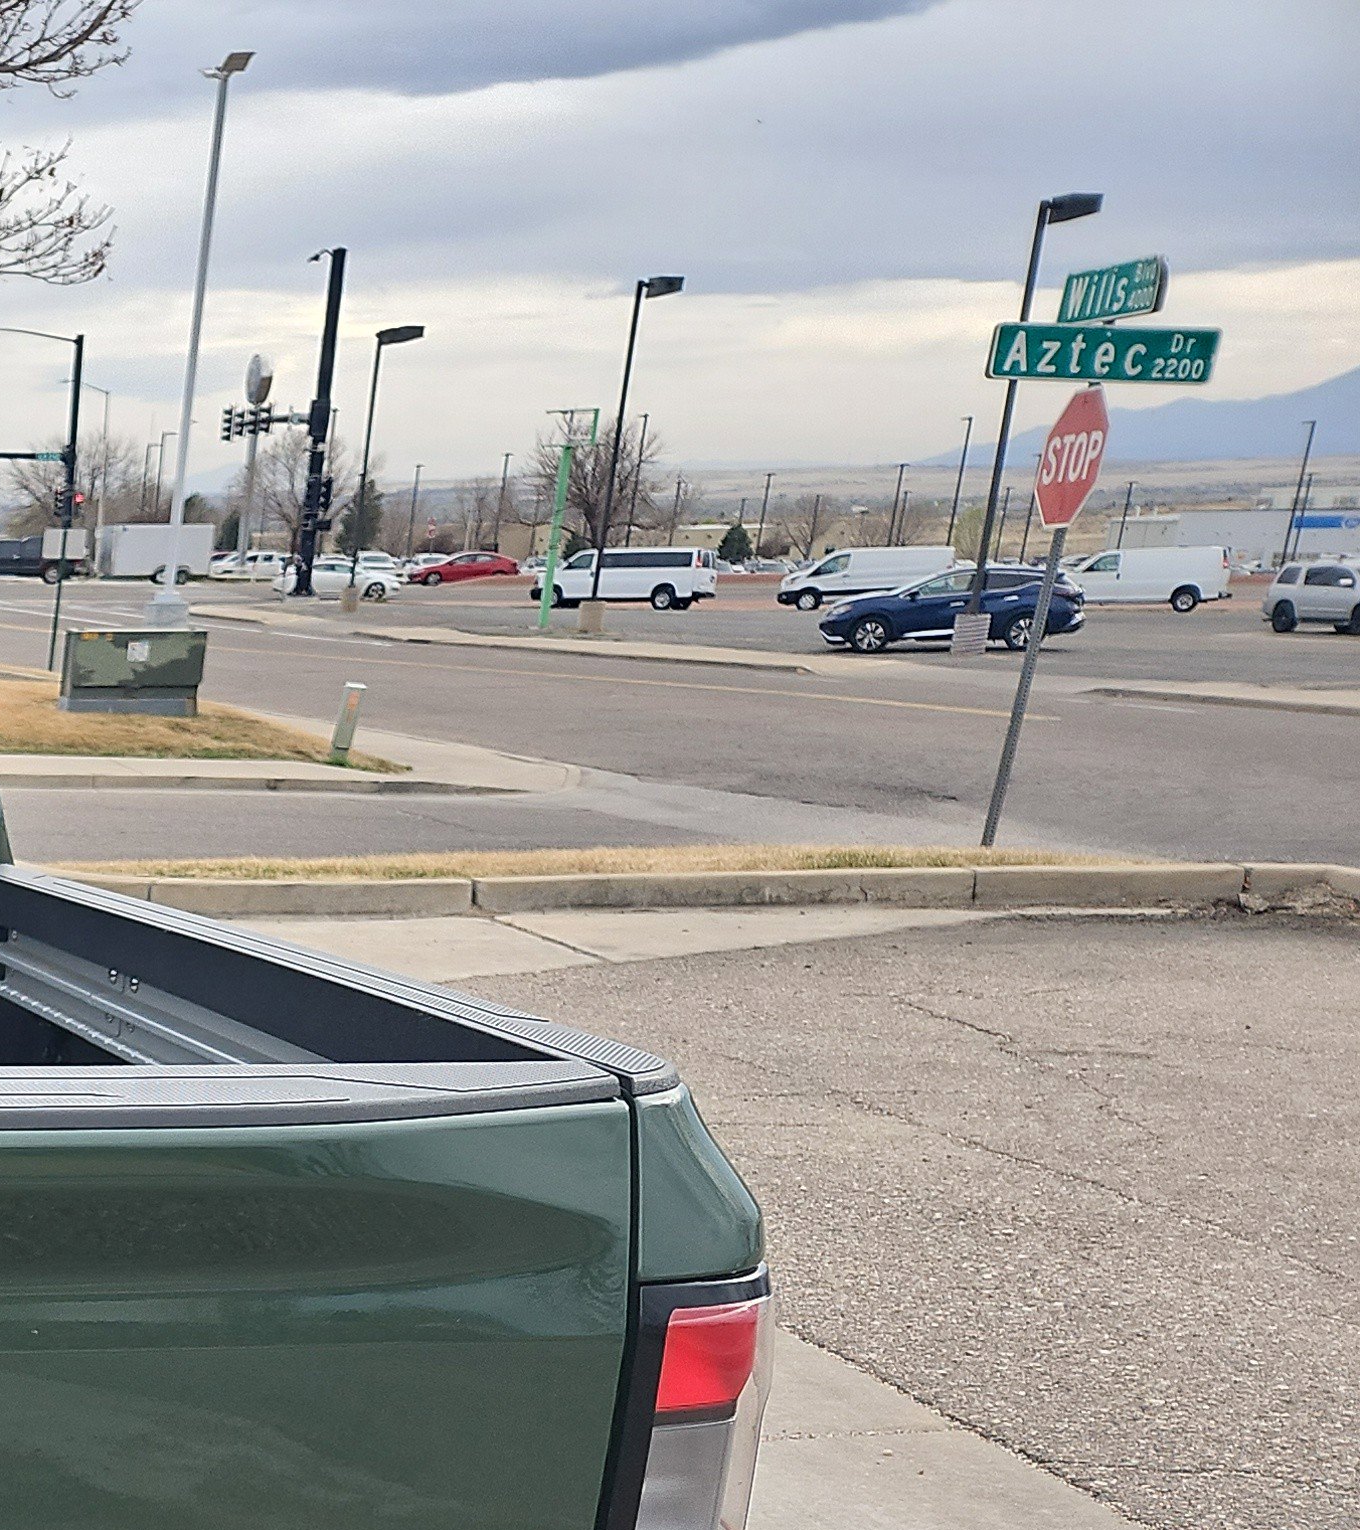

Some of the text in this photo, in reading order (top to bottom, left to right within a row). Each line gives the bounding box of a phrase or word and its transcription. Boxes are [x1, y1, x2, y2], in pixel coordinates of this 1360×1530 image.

[1067, 265, 1128, 320] Wills
[1003, 330, 1197, 377] Aztec Dr
[1151, 357, 1205, 379] 2200
[1041, 429, 1103, 486] STOP
